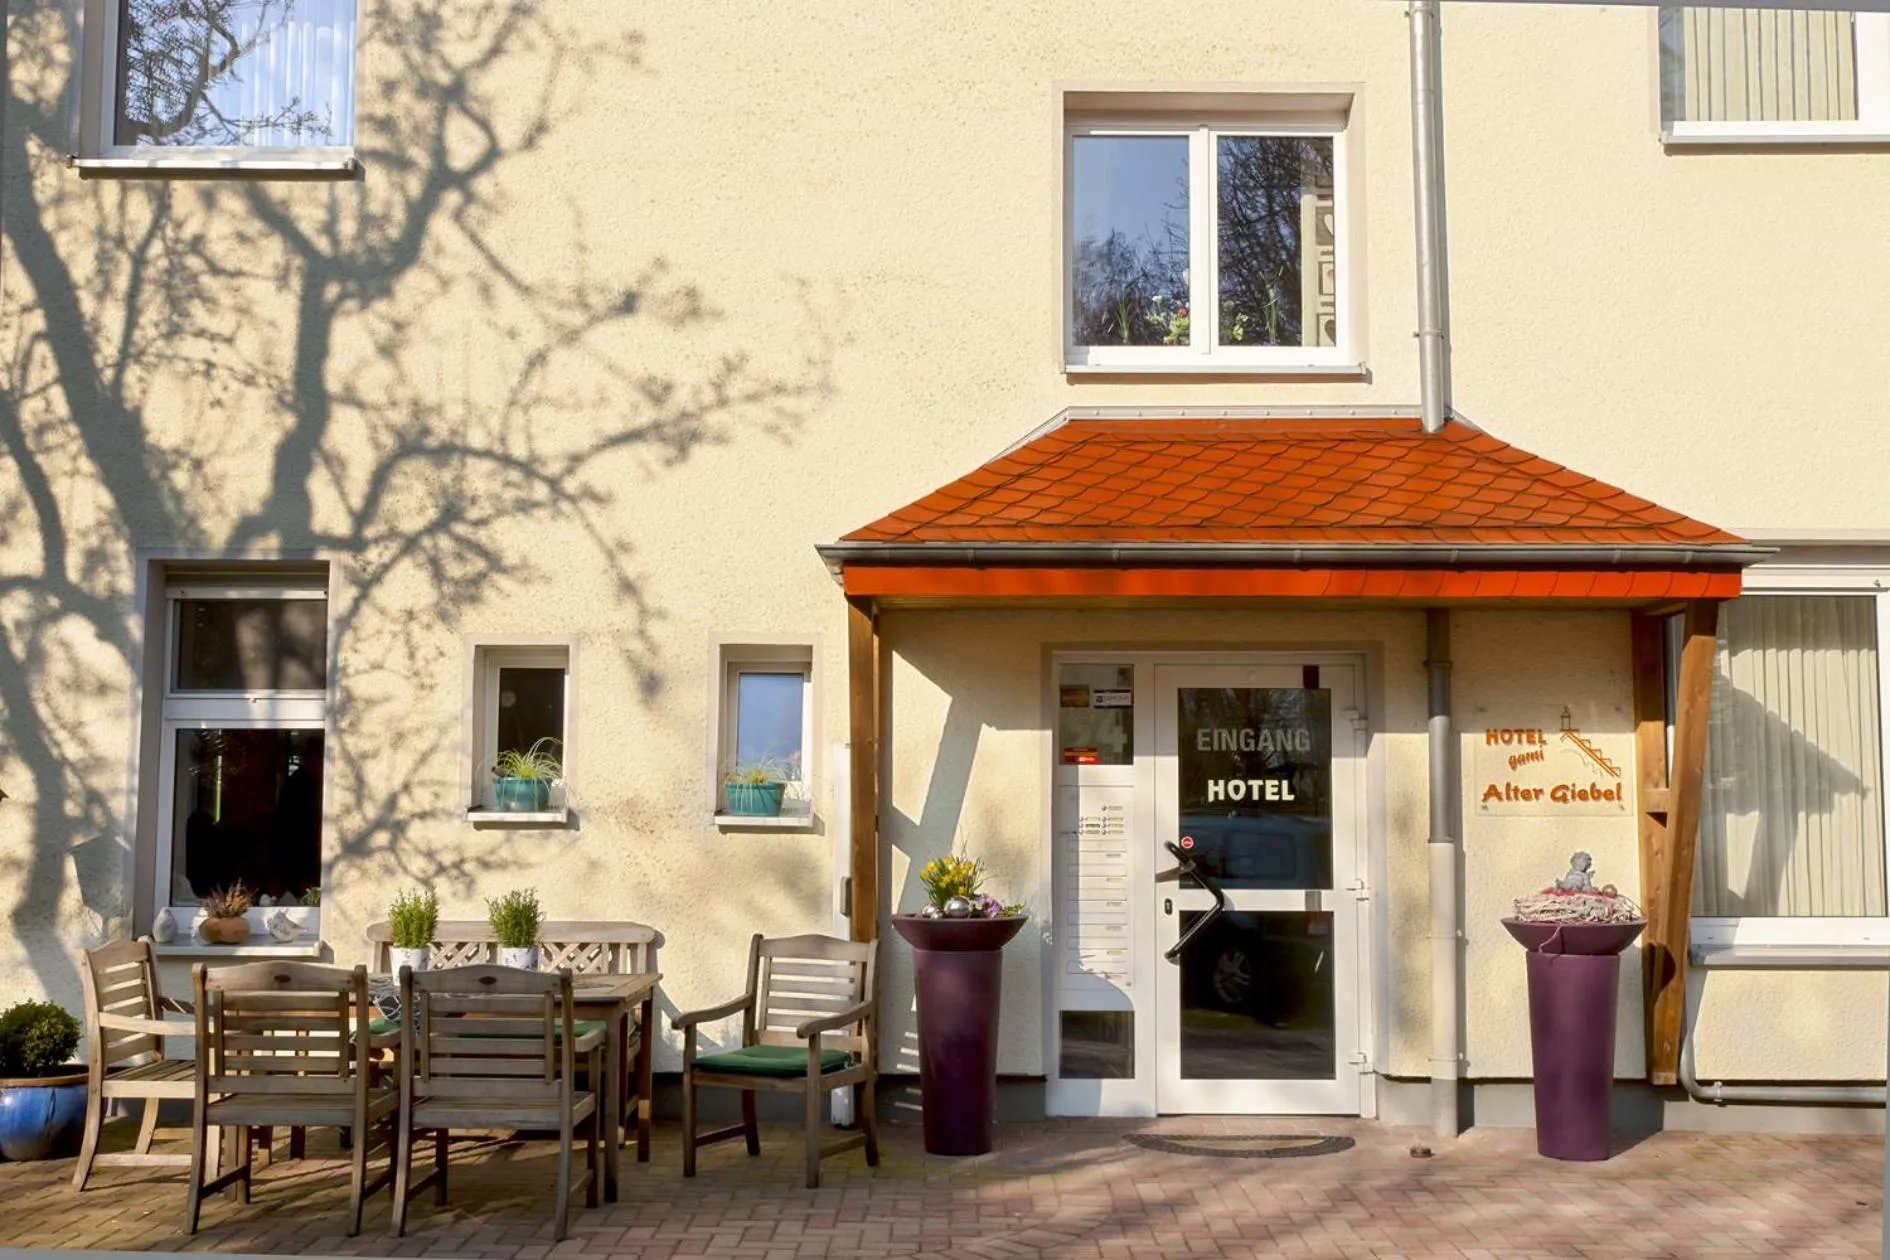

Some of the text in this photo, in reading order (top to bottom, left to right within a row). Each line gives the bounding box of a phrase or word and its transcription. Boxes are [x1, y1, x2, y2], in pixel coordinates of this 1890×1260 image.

[1196, 727, 1311, 752] EINGANG
[1485, 728, 1547, 746] HOTEL
[1207, 779, 1295, 803] HOTEL
[1482, 782, 1623, 805] Alter Giebel
